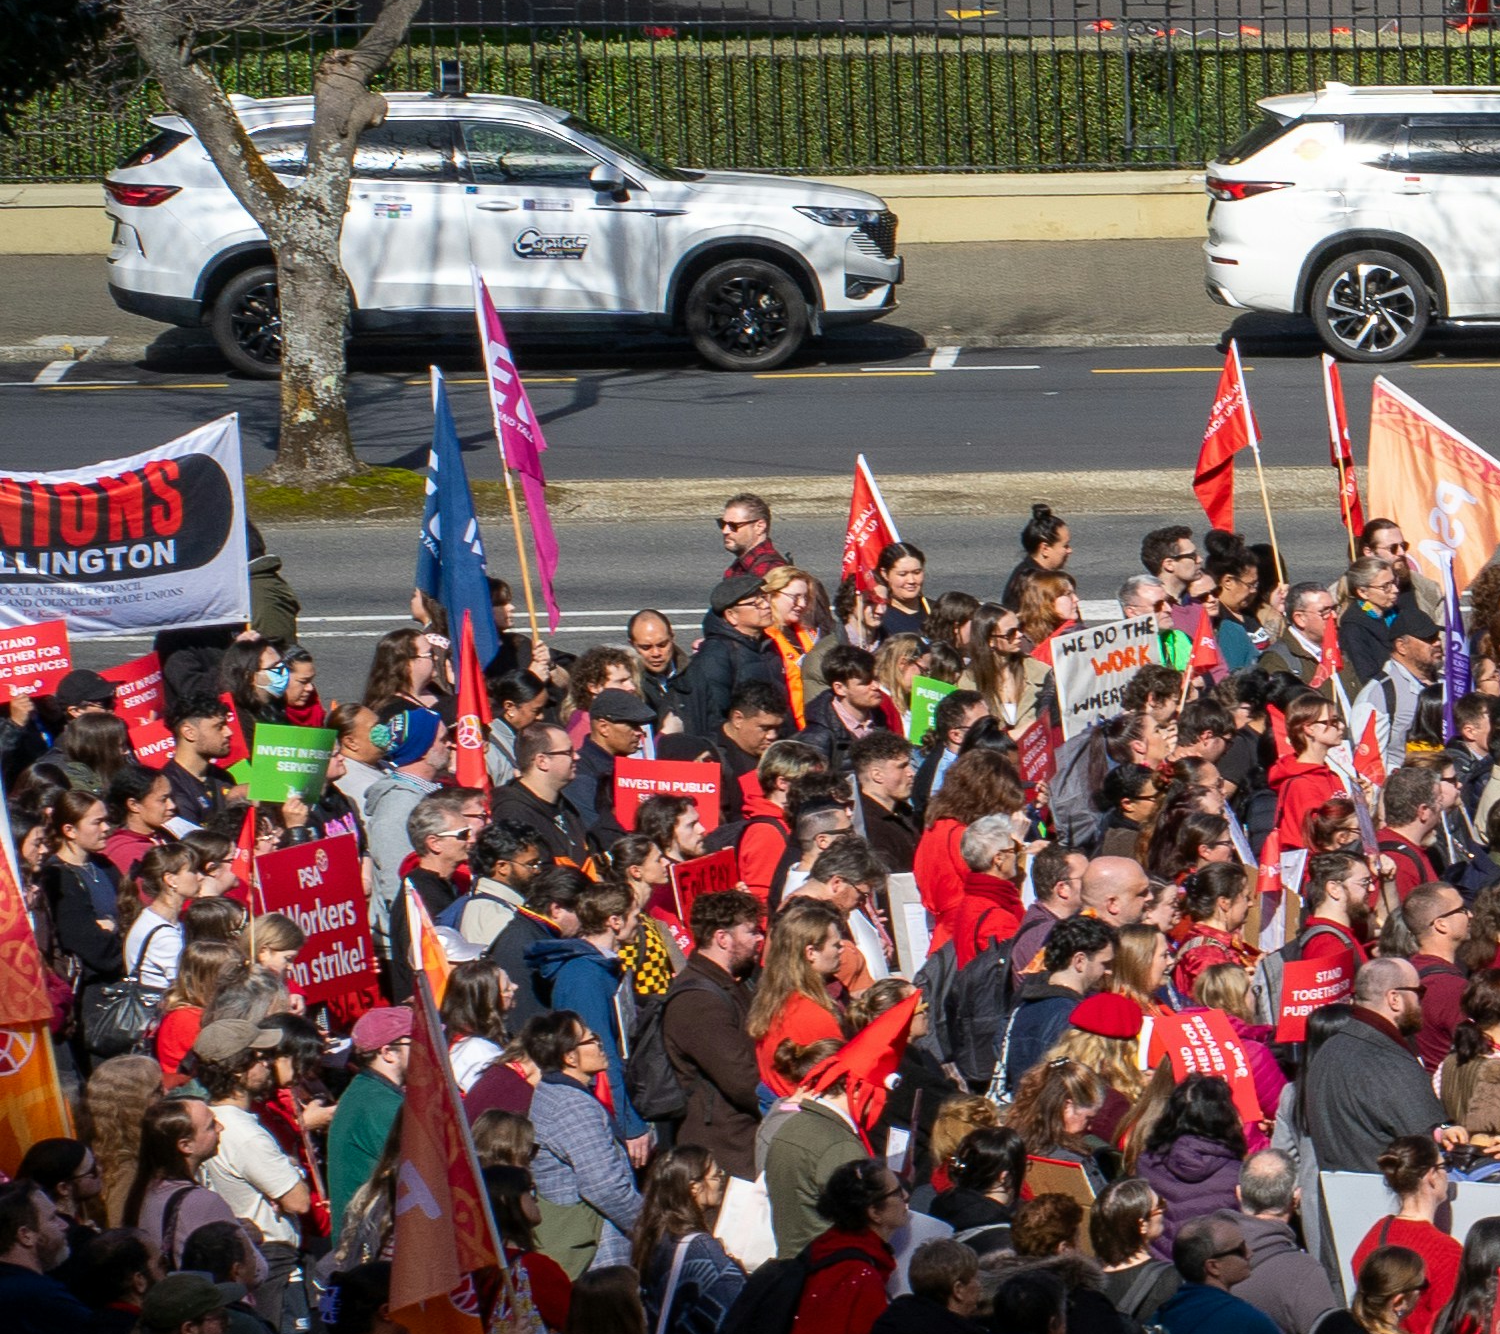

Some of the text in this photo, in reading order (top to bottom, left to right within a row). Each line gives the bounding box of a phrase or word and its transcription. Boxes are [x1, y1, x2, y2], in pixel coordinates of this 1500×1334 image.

[515, 420, 535, 444] TALL
[34, 595, 87, 608] COUNCIL
[88, 595, 105, 606] OF
[106, 592, 144, 605] TRADE
[145, 586, 185, 602] UNIONS
[94, 582, 144, 595] COUNCIL
[1062, 615, 1156, 657] WE DO THE
[37, 646, 62, 660] FOR
[1090, 643, 1152, 677] WORK
[14, 658, 69, 677] SERVICES
[140, 737, 176, 757] INVES
[257, 745, 297, 759] INVEST
[297, 747, 309, 759] IN
[617, 777, 716, 794] INVEST IN PUBLIC
[297, 865, 323, 890] PSA
[280, 898, 357, 937] Workers
[310, 936, 366, 984] strike!
[1315, 966, 1343, 985] STAND
